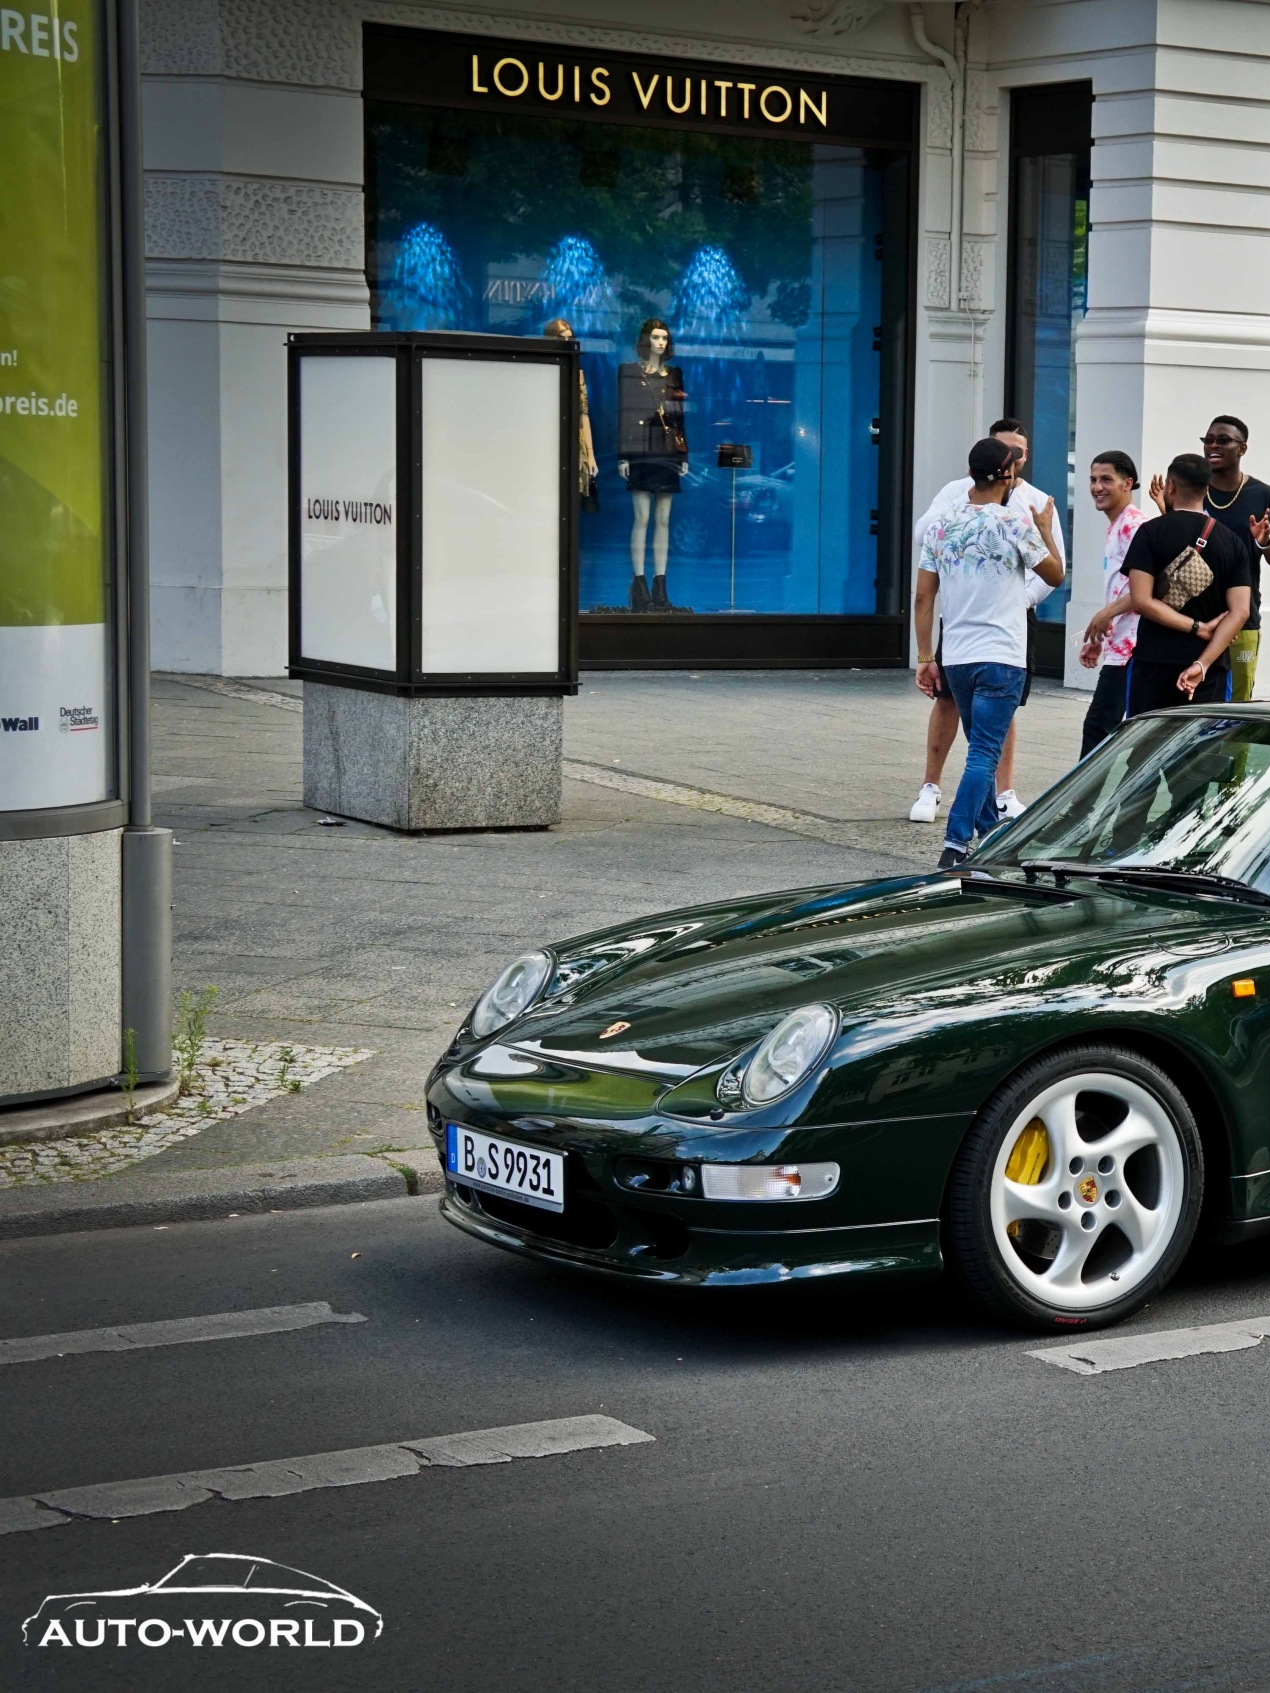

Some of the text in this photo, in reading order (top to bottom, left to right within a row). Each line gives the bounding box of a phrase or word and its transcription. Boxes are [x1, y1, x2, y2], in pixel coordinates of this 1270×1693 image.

[472, 54, 827, 127] LOUIS VUITTON
[307, 498, 392, 525] LOUIS VUITTON
[2, 717, 39, 731] Wall
[60, 706, 93, 718] Deutscher
[464, 1134, 555, 1197] B S 9931
